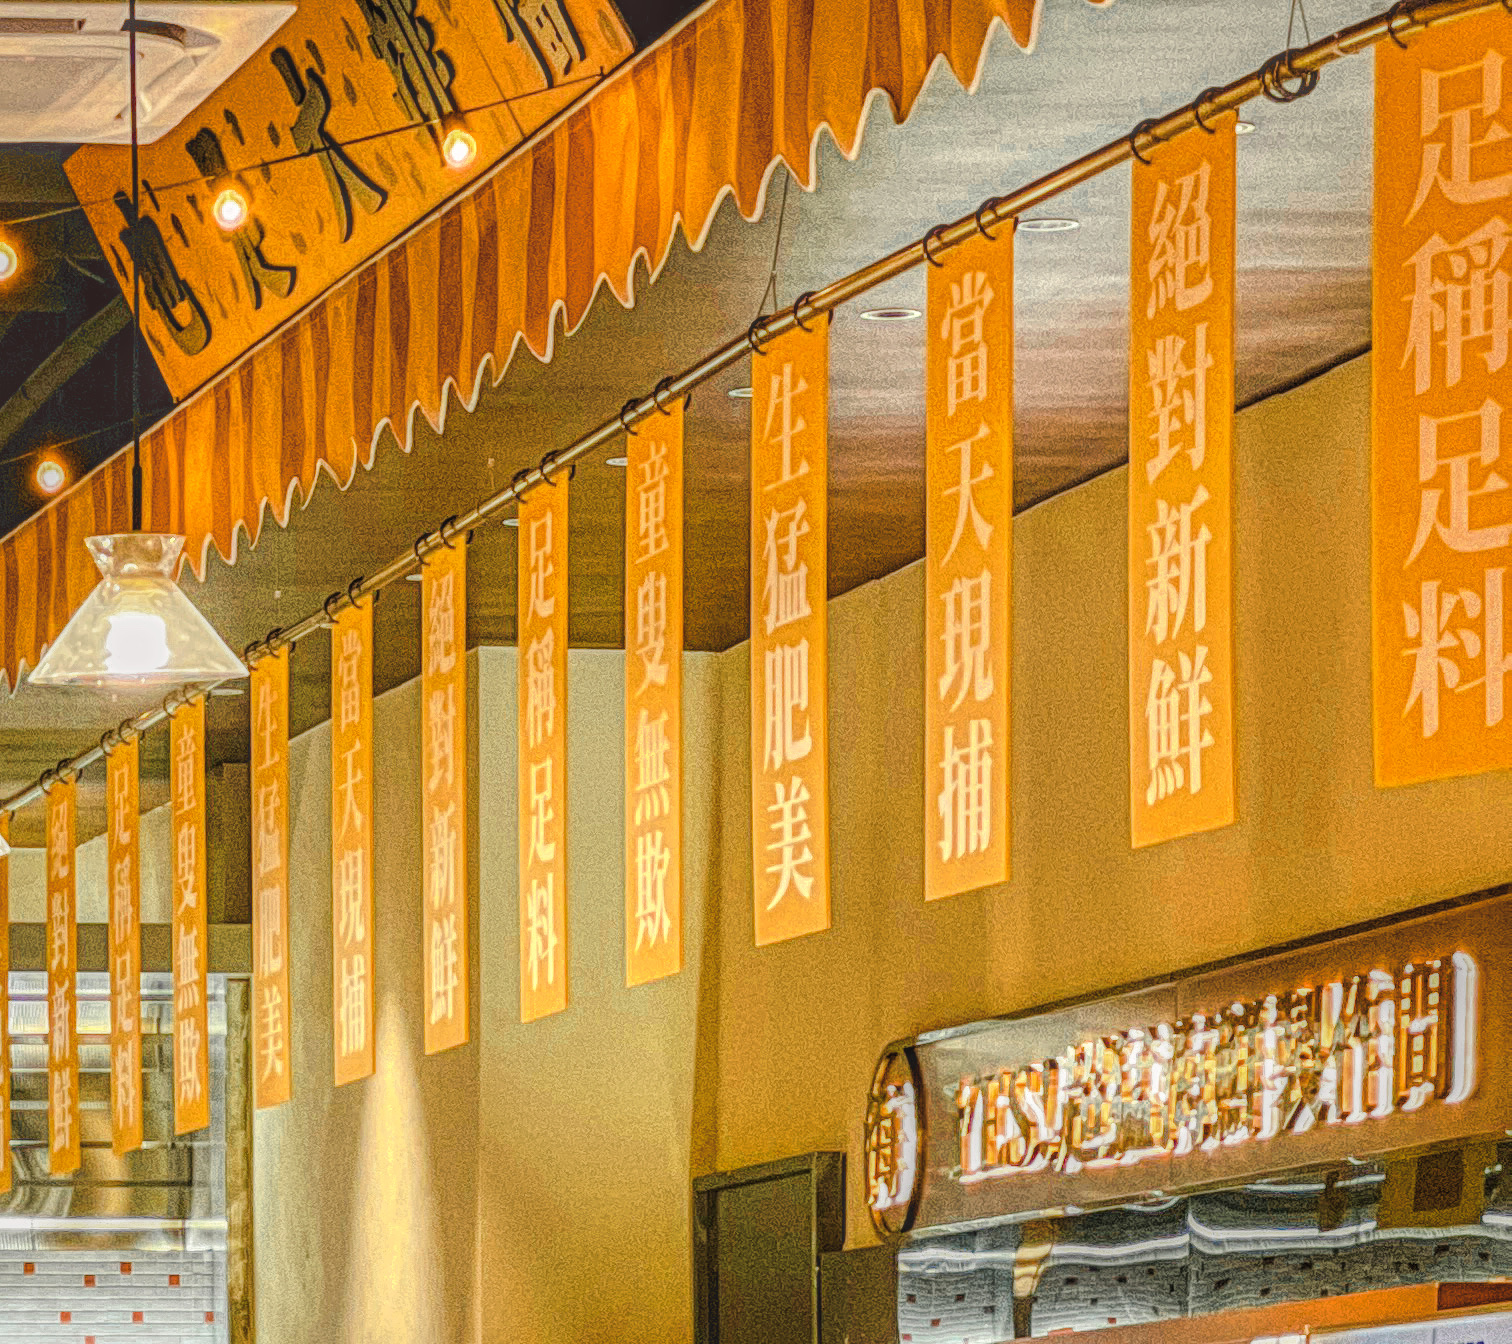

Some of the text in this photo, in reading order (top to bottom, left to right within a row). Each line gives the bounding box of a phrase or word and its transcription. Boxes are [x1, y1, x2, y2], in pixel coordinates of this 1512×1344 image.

[525, 511, 559, 992] 足稱足料
[761, 363, 815, 912] 生猛肥美
[937, 270, 995, 864] 當天現捕
[1145, 162, 1215, 806] 絕對新鮮
